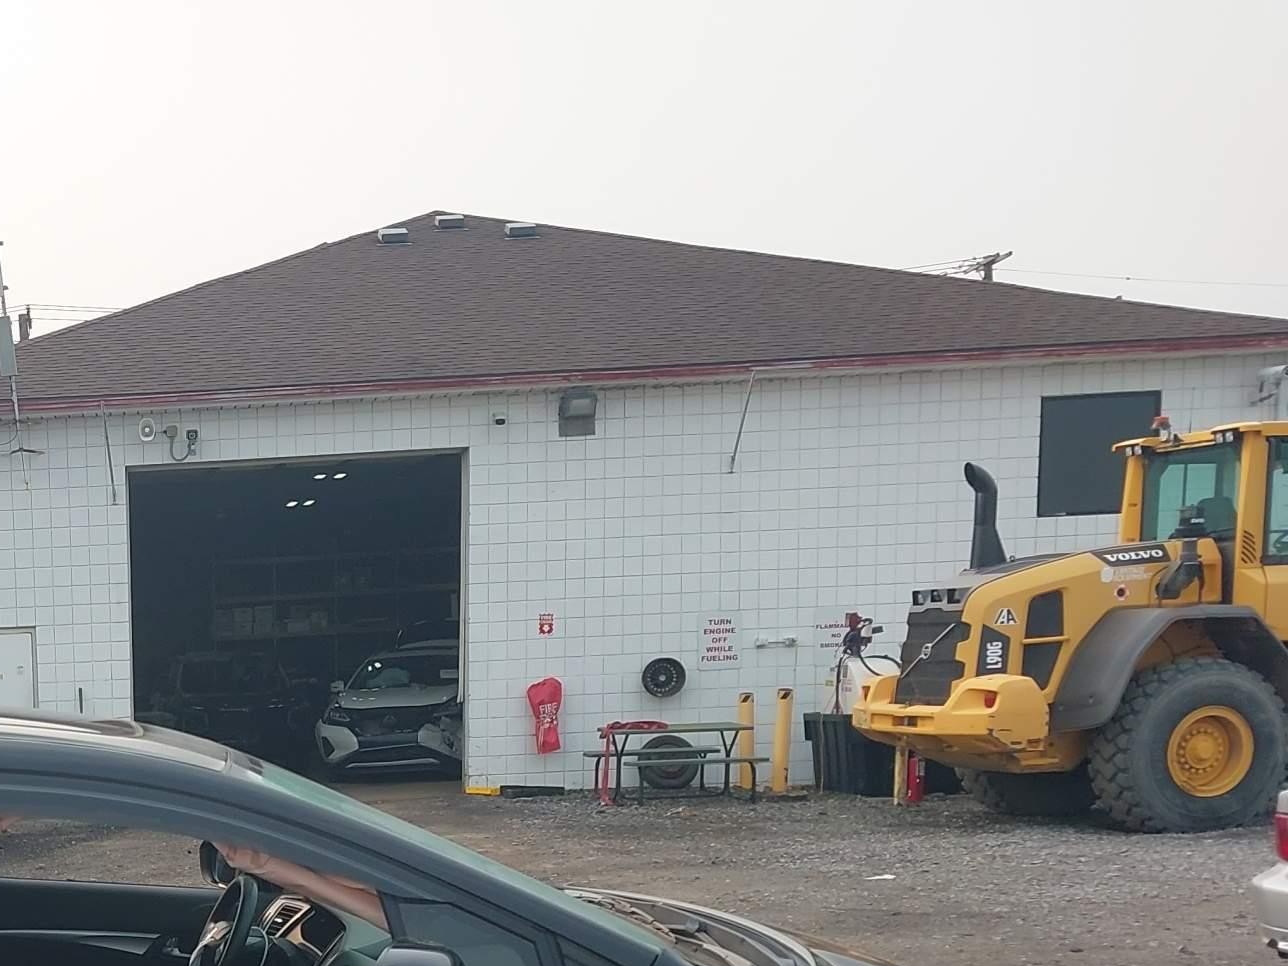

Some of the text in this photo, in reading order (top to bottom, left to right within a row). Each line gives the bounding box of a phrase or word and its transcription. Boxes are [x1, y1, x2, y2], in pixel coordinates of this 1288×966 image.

[1103, 549, 1164, 562] VOLVO
[708, 618, 732, 626] TURN
[703, 627, 737, 635] ENGINE
[711, 636, 729, 644] OFF
[706, 645, 734, 653] WHILE
[700, 654, 739, 662] FUELING
[985, 641, 1003, 669] L90G
